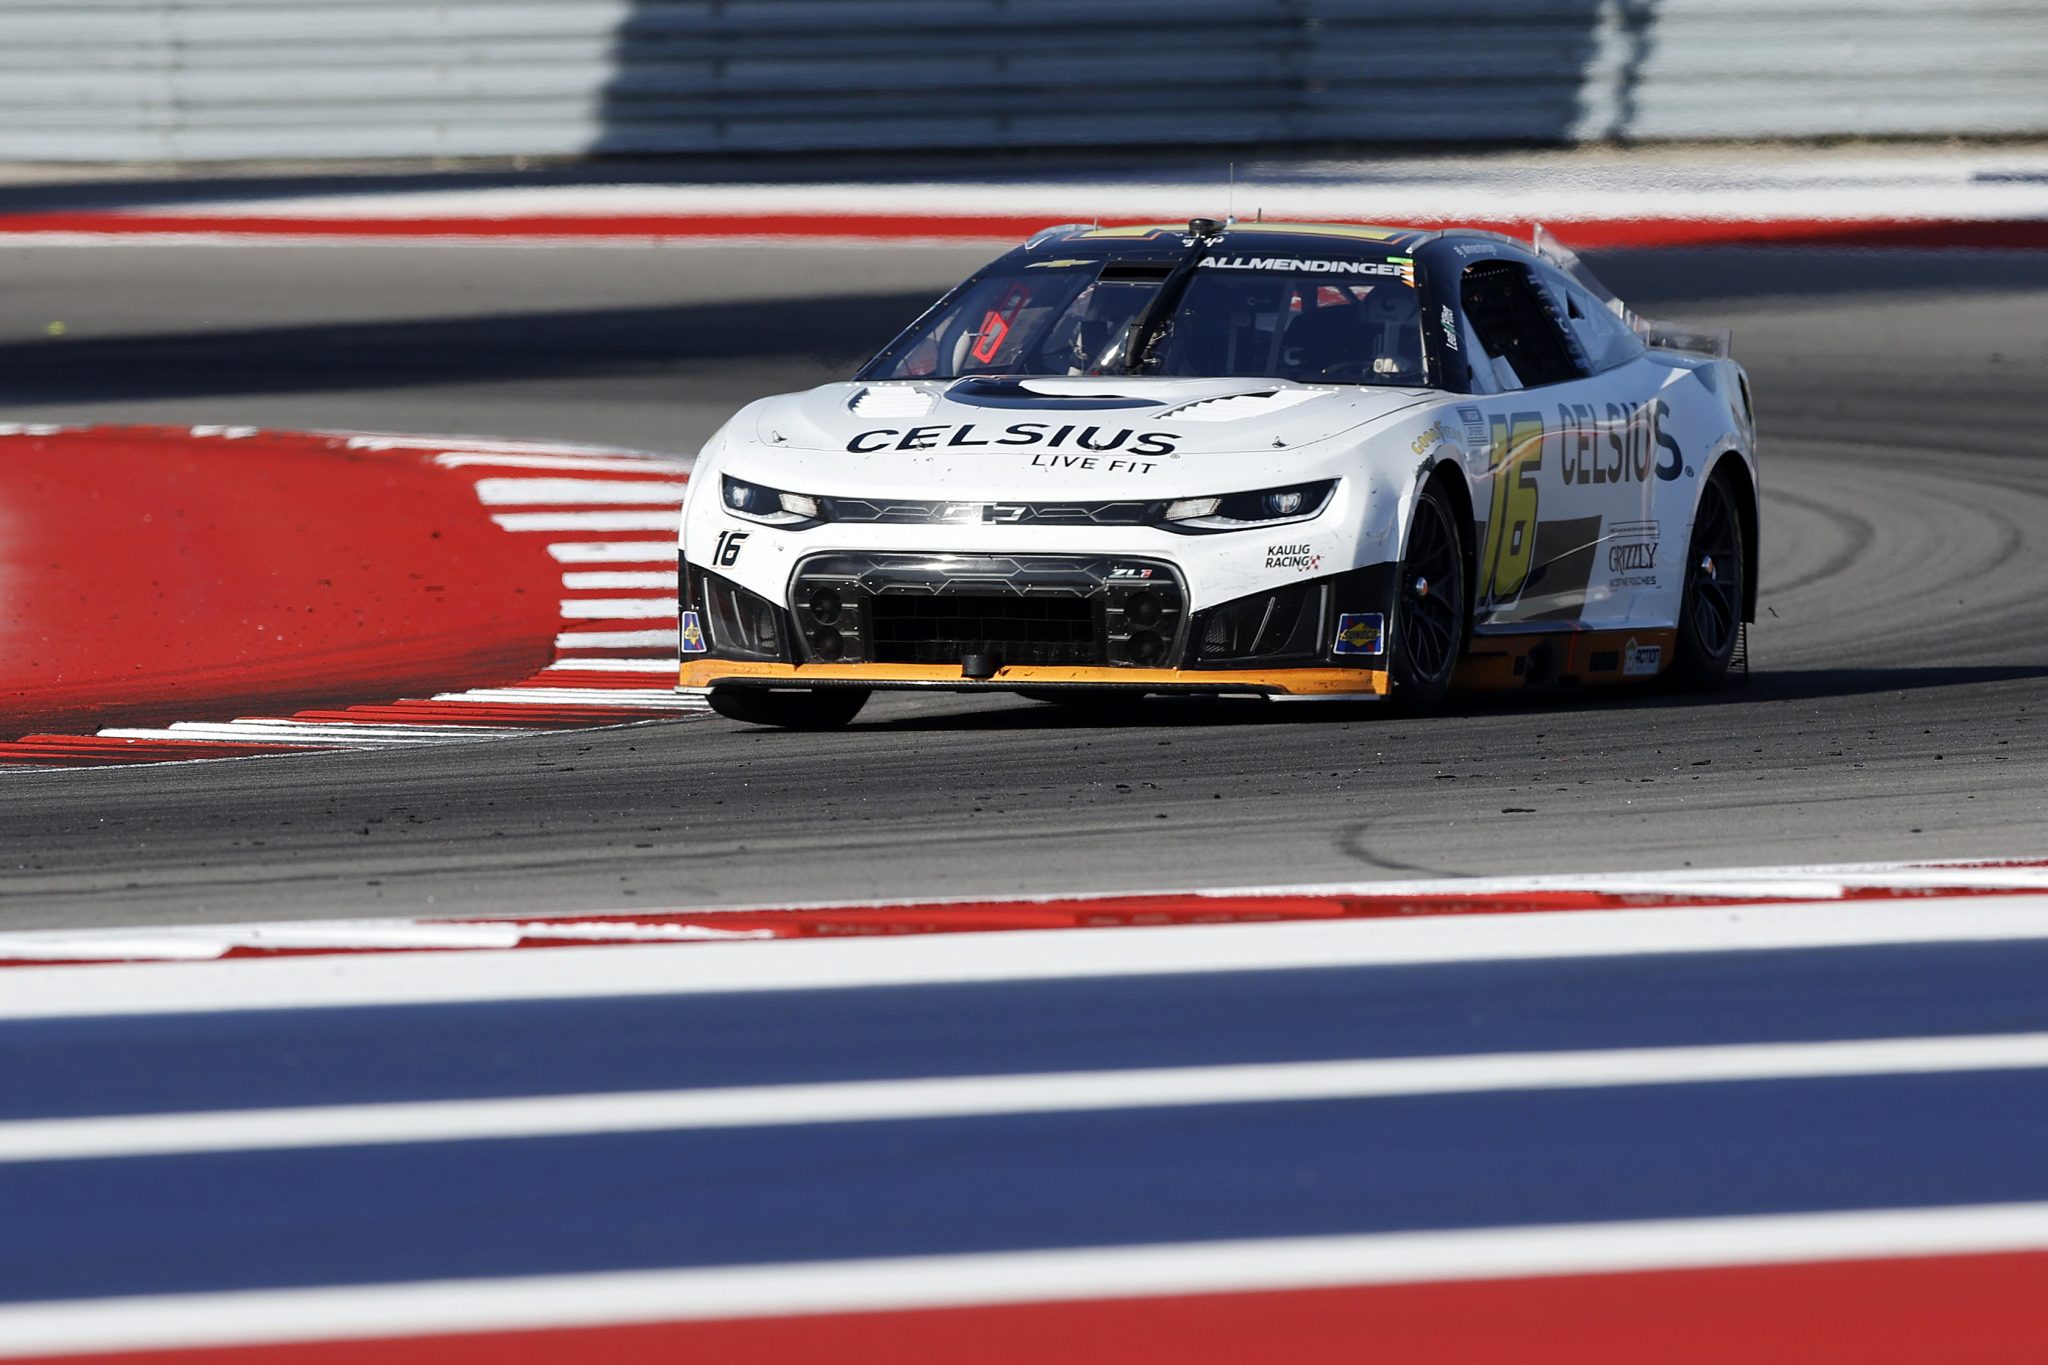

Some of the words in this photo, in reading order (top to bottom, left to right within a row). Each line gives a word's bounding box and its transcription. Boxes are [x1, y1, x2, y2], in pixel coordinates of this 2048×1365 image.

[846, 423, 1183, 457] CELSIUS
[1557, 400, 1684, 486] CELSIUS
[1031, 454, 1100, 470] LIVE
[1108, 460, 1157, 474] FIT
[1479, 411, 1545, 599] 16
[711, 530, 750, 567] 16
[1266, 556, 1309, 568] RACING
[1268, 544, 1310, 556] KAULIG
[1609, 542, 1659, 575] GRIZZLY
[1109, 568, 1153, 579] ZL1
